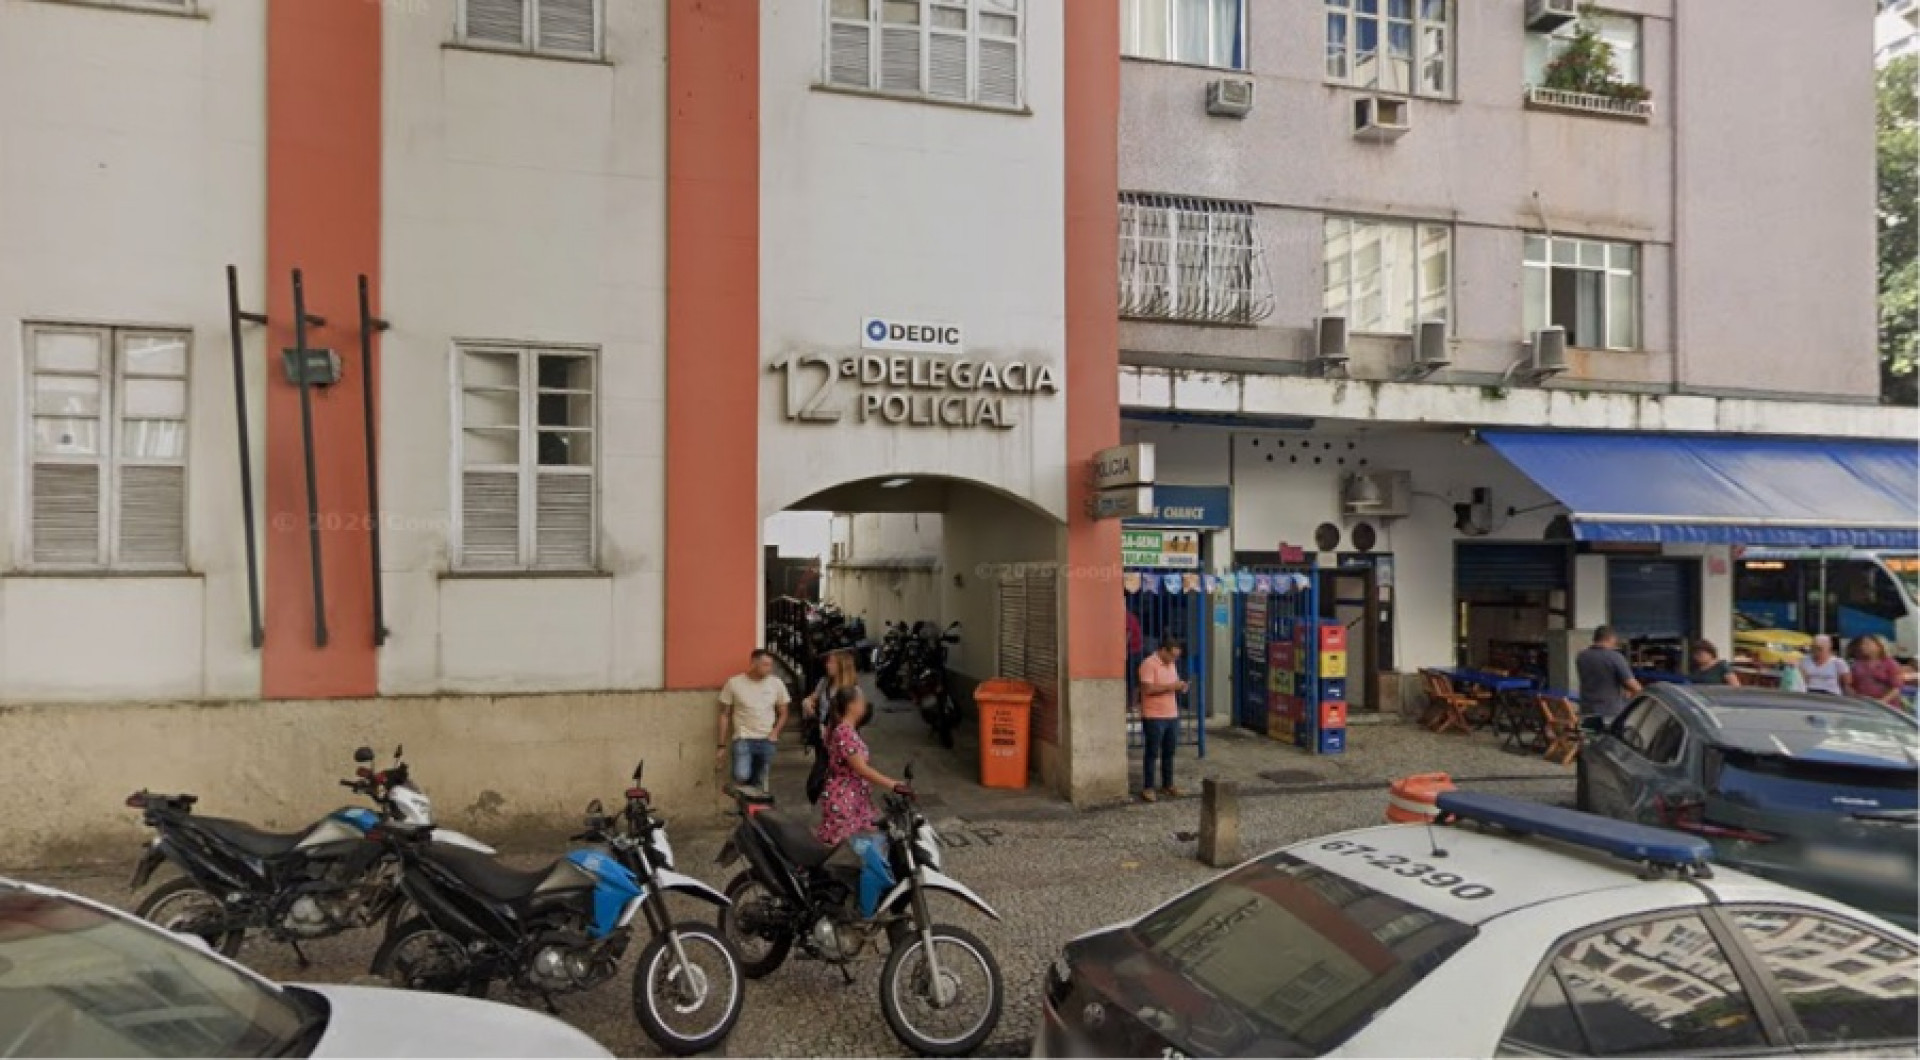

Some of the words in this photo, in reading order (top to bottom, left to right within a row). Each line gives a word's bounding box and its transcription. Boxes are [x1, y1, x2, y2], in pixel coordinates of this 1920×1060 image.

[888, 322, 960, 346] DEDIC
[861, 353, 1057, 393] DELEGACIA
[861, 391, 1015, 431] POLICIAL
[1163, 506, 1205, 519] CHANCE
[1320, 841, 1495, 900] 67-2390
